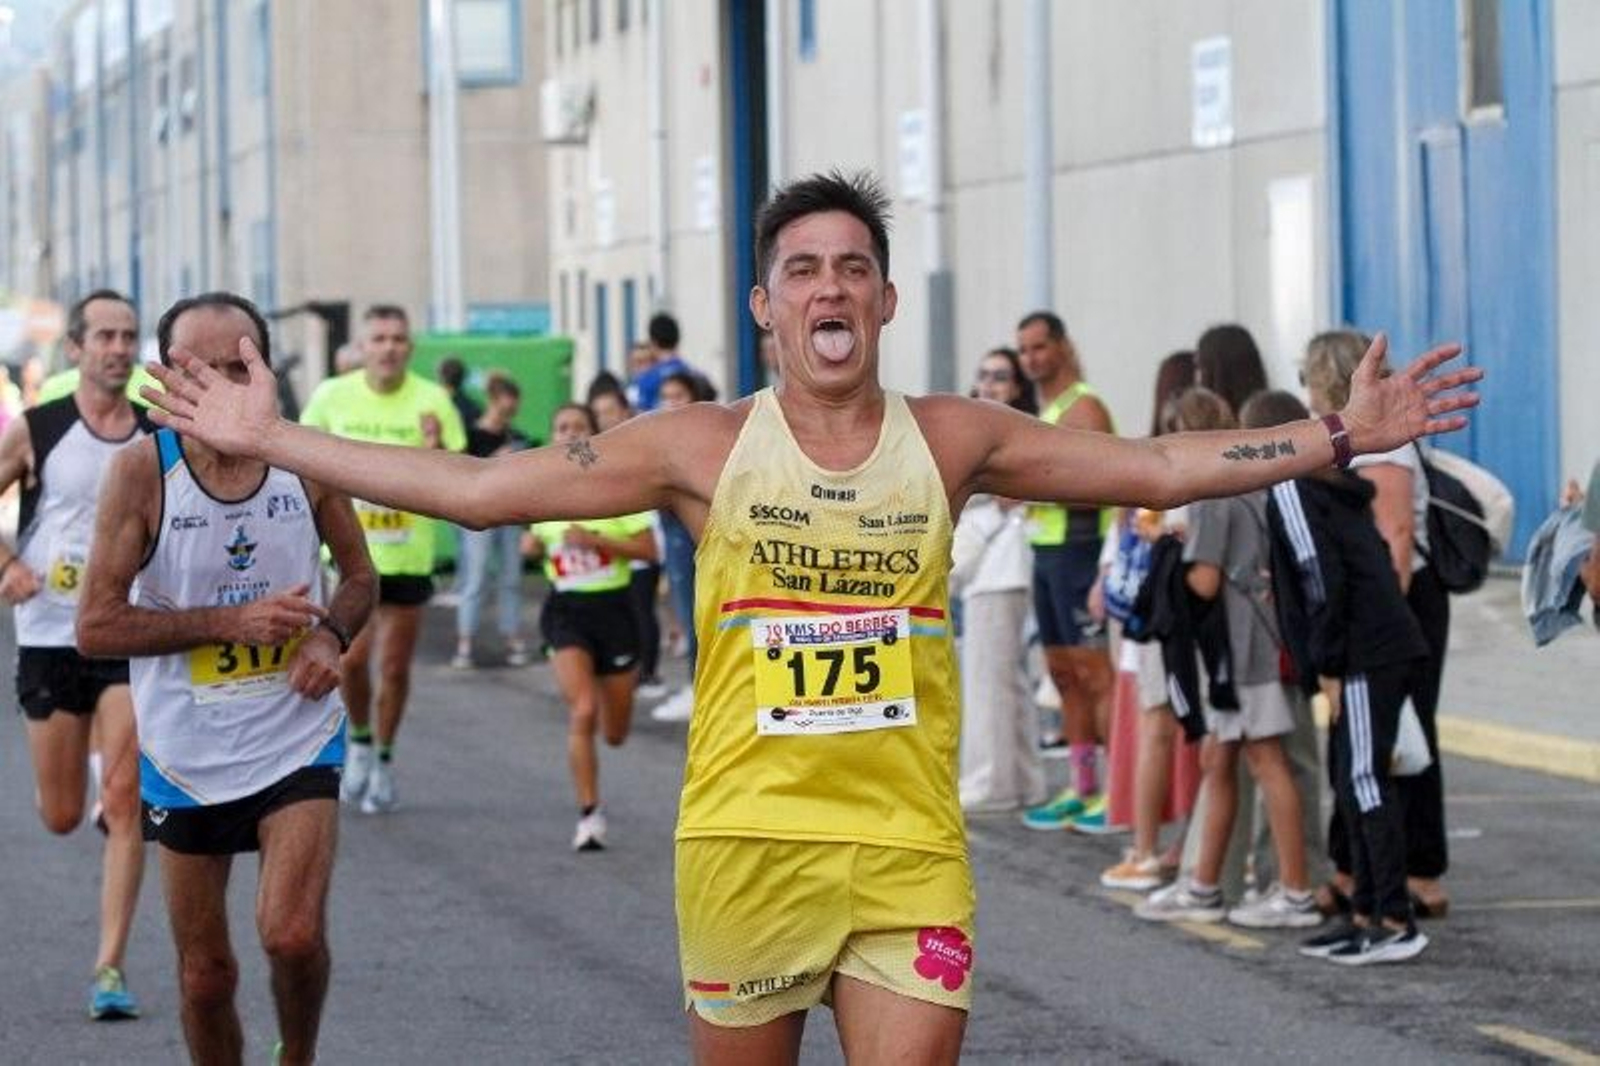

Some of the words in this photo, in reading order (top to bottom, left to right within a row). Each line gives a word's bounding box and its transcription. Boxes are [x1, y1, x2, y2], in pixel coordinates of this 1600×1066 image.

[858, 515, 885, 529] San
[887, 511, 929, 527] Lázaro
[750, 540, 920, 574] ATHLETICS
[772, 567, 812, 592] San
[819, 573, 896, 597] Lázaro
[785, 623, 815, 636] KMS
[819, 620, 842, 634] DO
[216, 640, 284, 673] 317
[787, 646, 881, 697] 175
